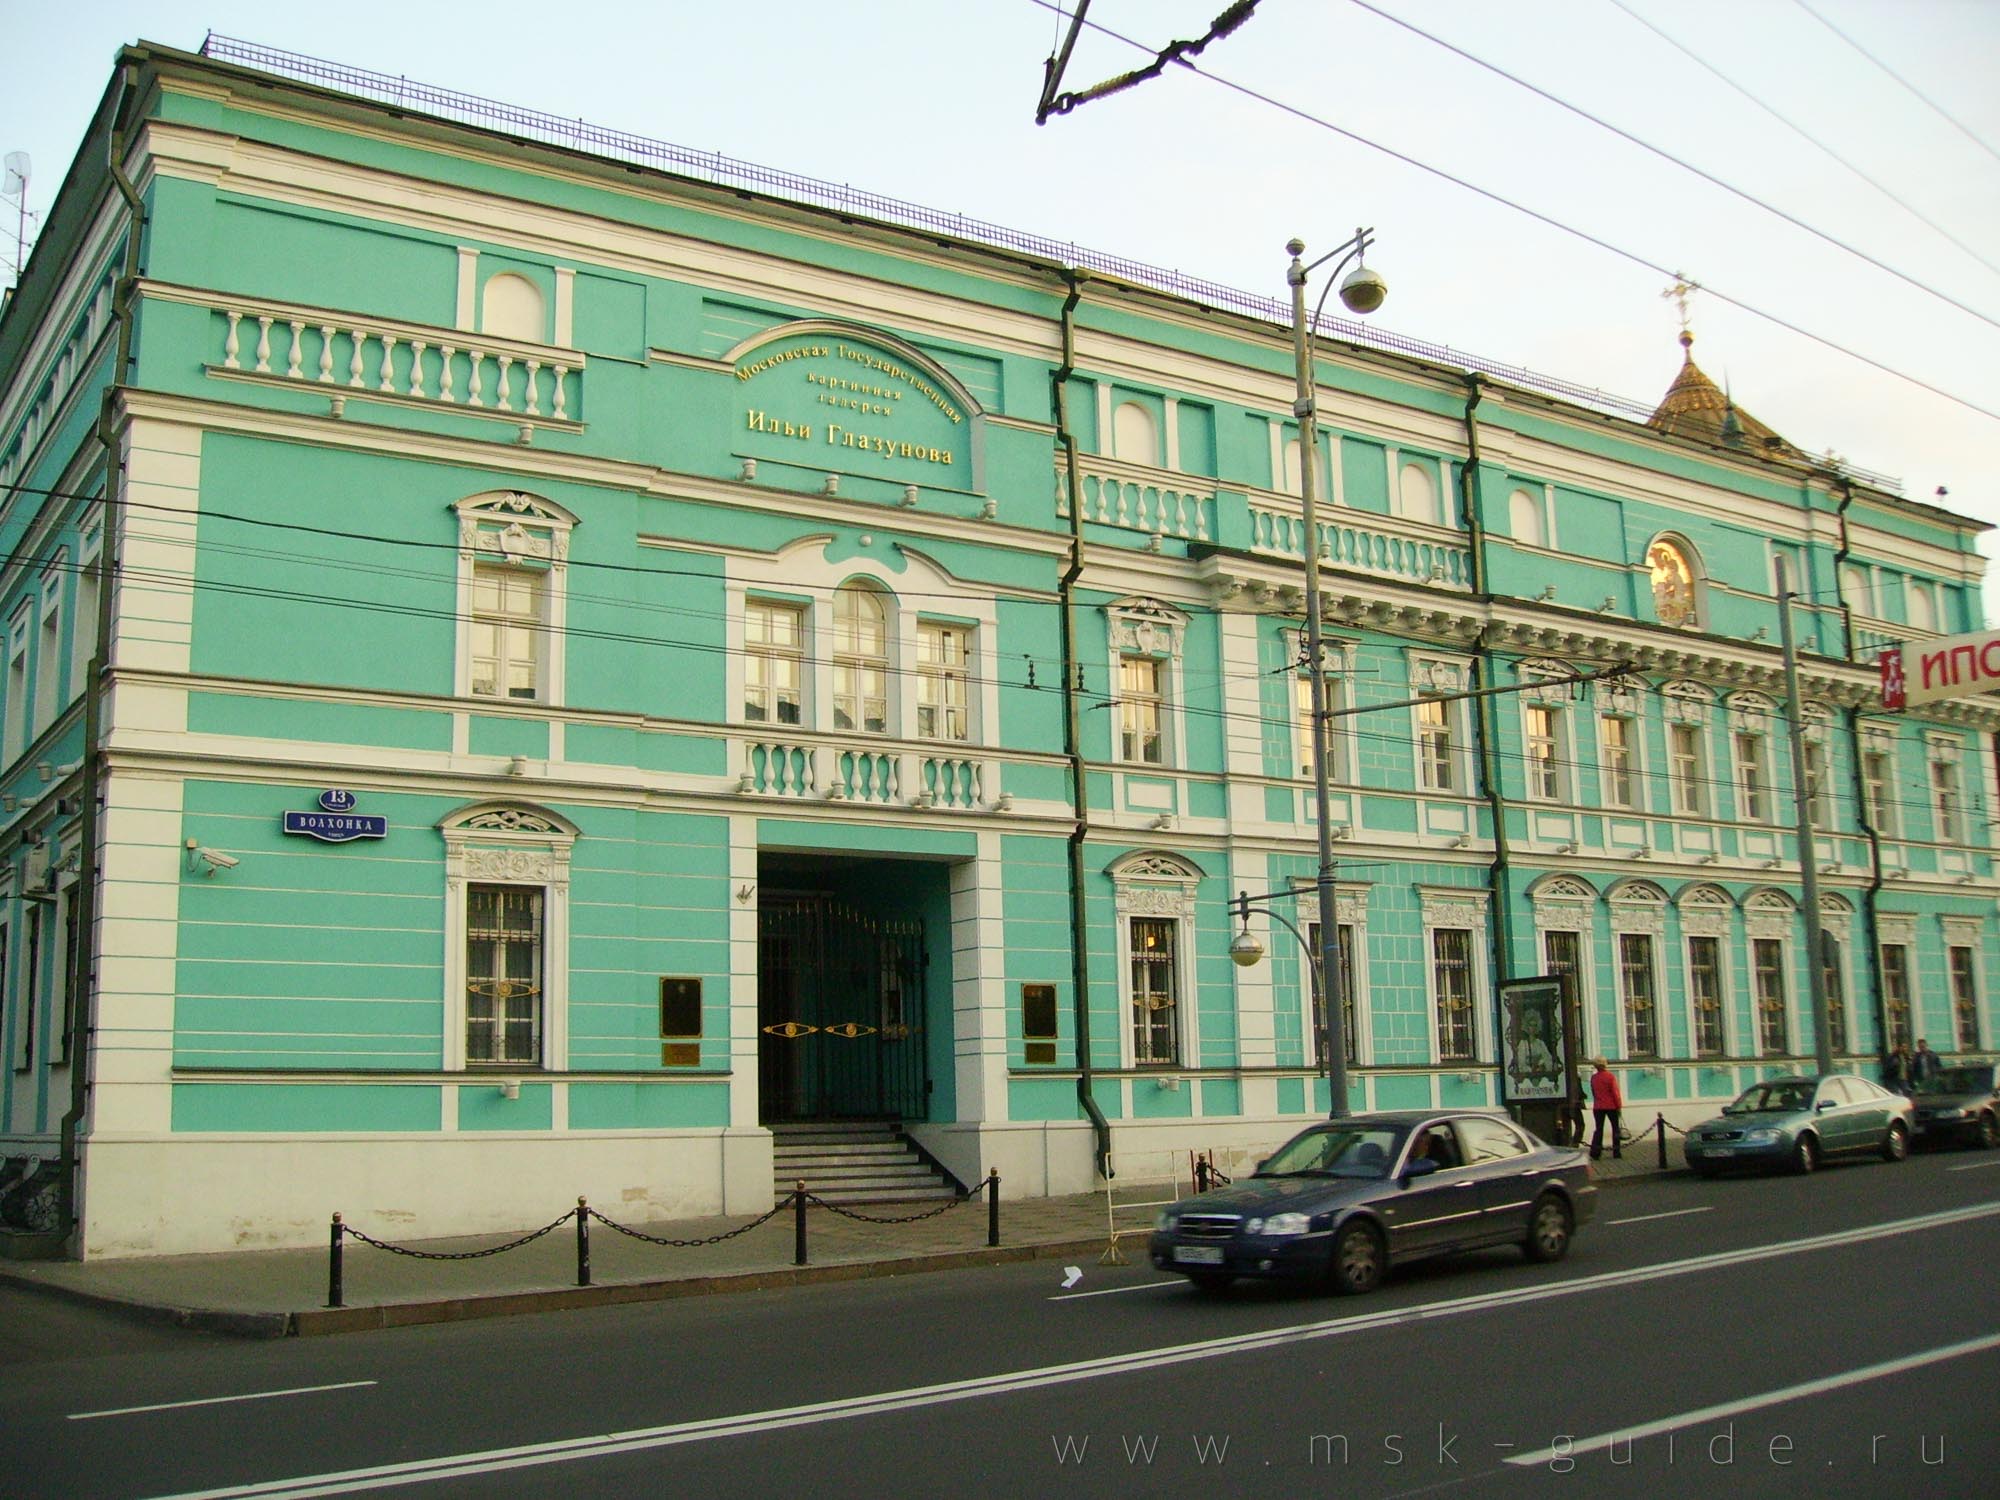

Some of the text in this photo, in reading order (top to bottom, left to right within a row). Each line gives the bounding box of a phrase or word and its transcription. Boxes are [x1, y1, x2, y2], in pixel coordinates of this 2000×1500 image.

[736, 344, 961, 424] Московская Государственная
[808, 371, 902, 401] картинная
[818, 392, 892, 417] галерея
[747, 409, 953, 466] Ильи Глазунова
[330, 790, 346, 803] 13
[300, 816, 372, 831] ВОЛХОНКА
